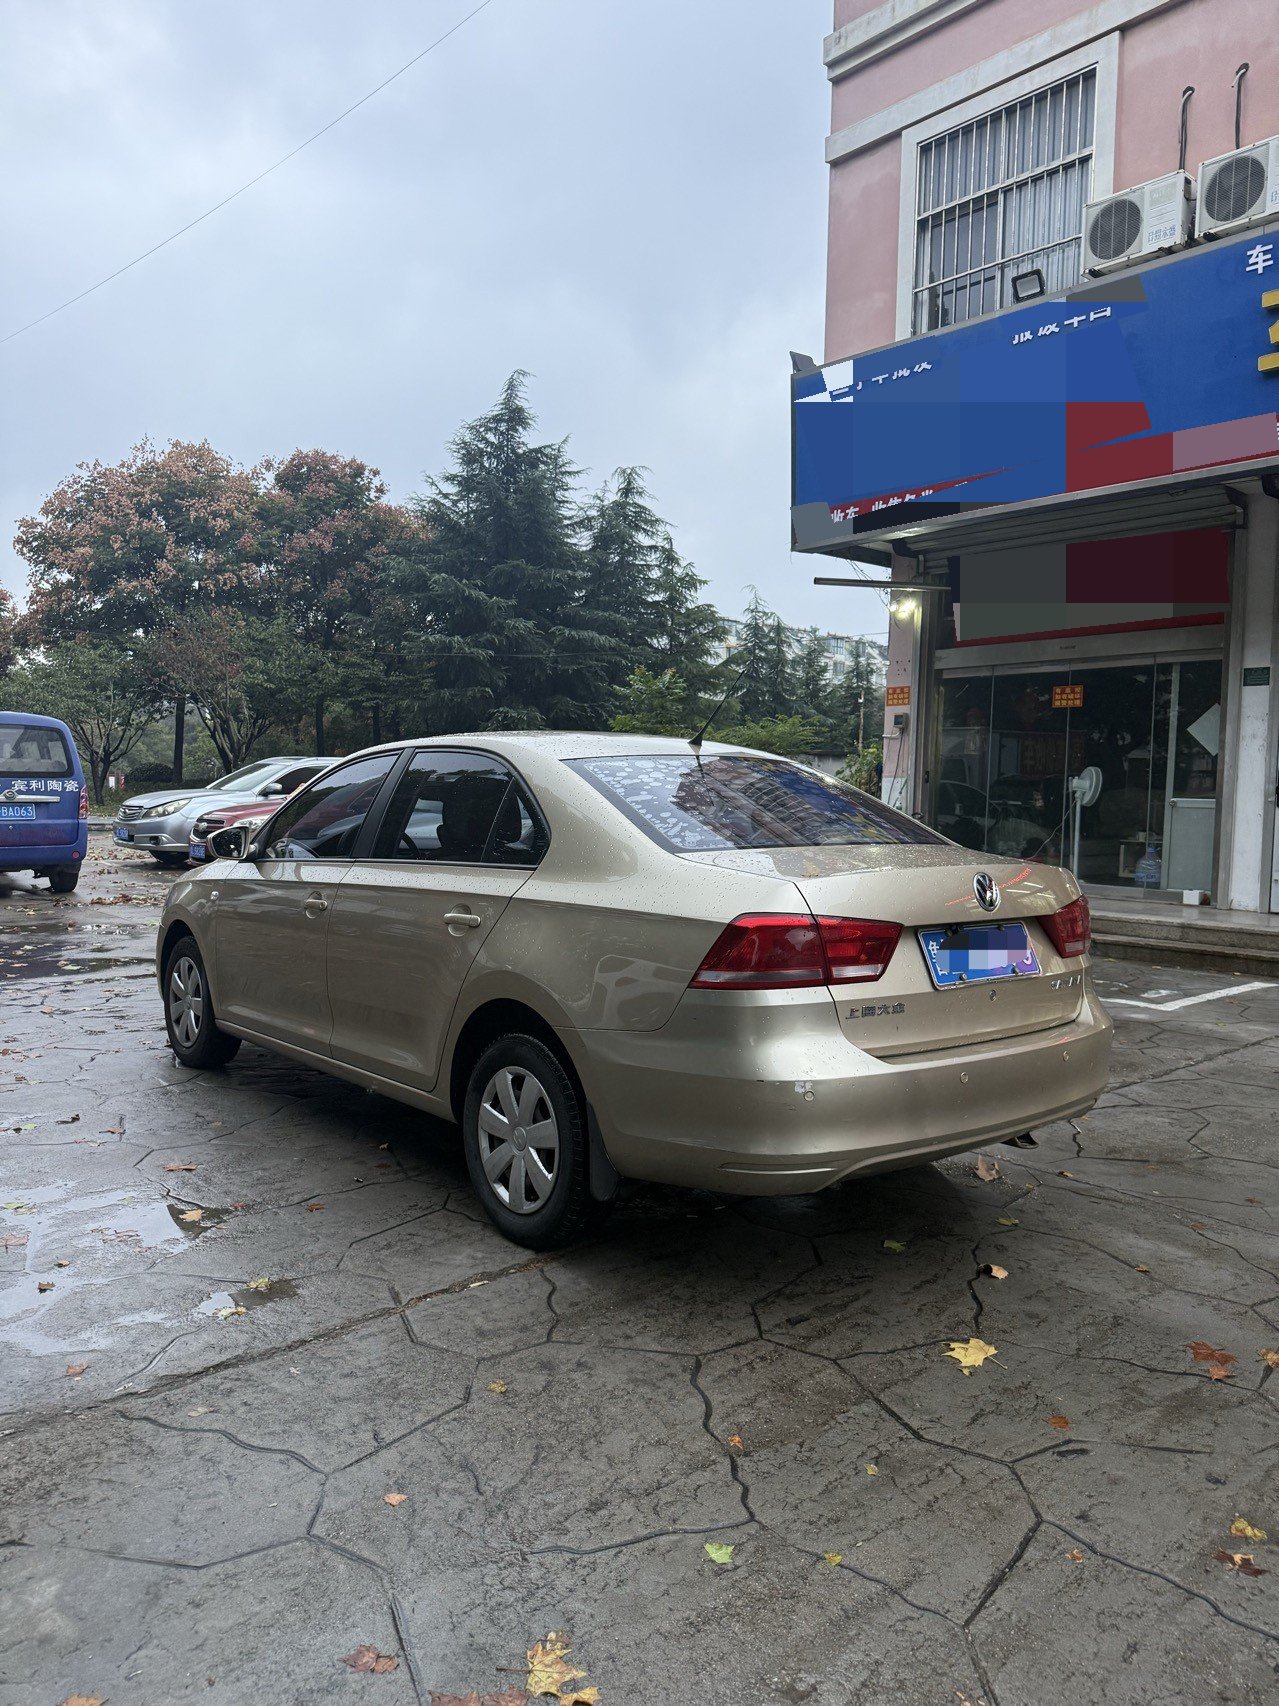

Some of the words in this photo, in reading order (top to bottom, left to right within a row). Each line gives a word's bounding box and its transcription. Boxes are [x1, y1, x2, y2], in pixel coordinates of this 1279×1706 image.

[1245, 243, 1274, 275] 车
[11, 779, 79, 792] 宾利陶瓷
